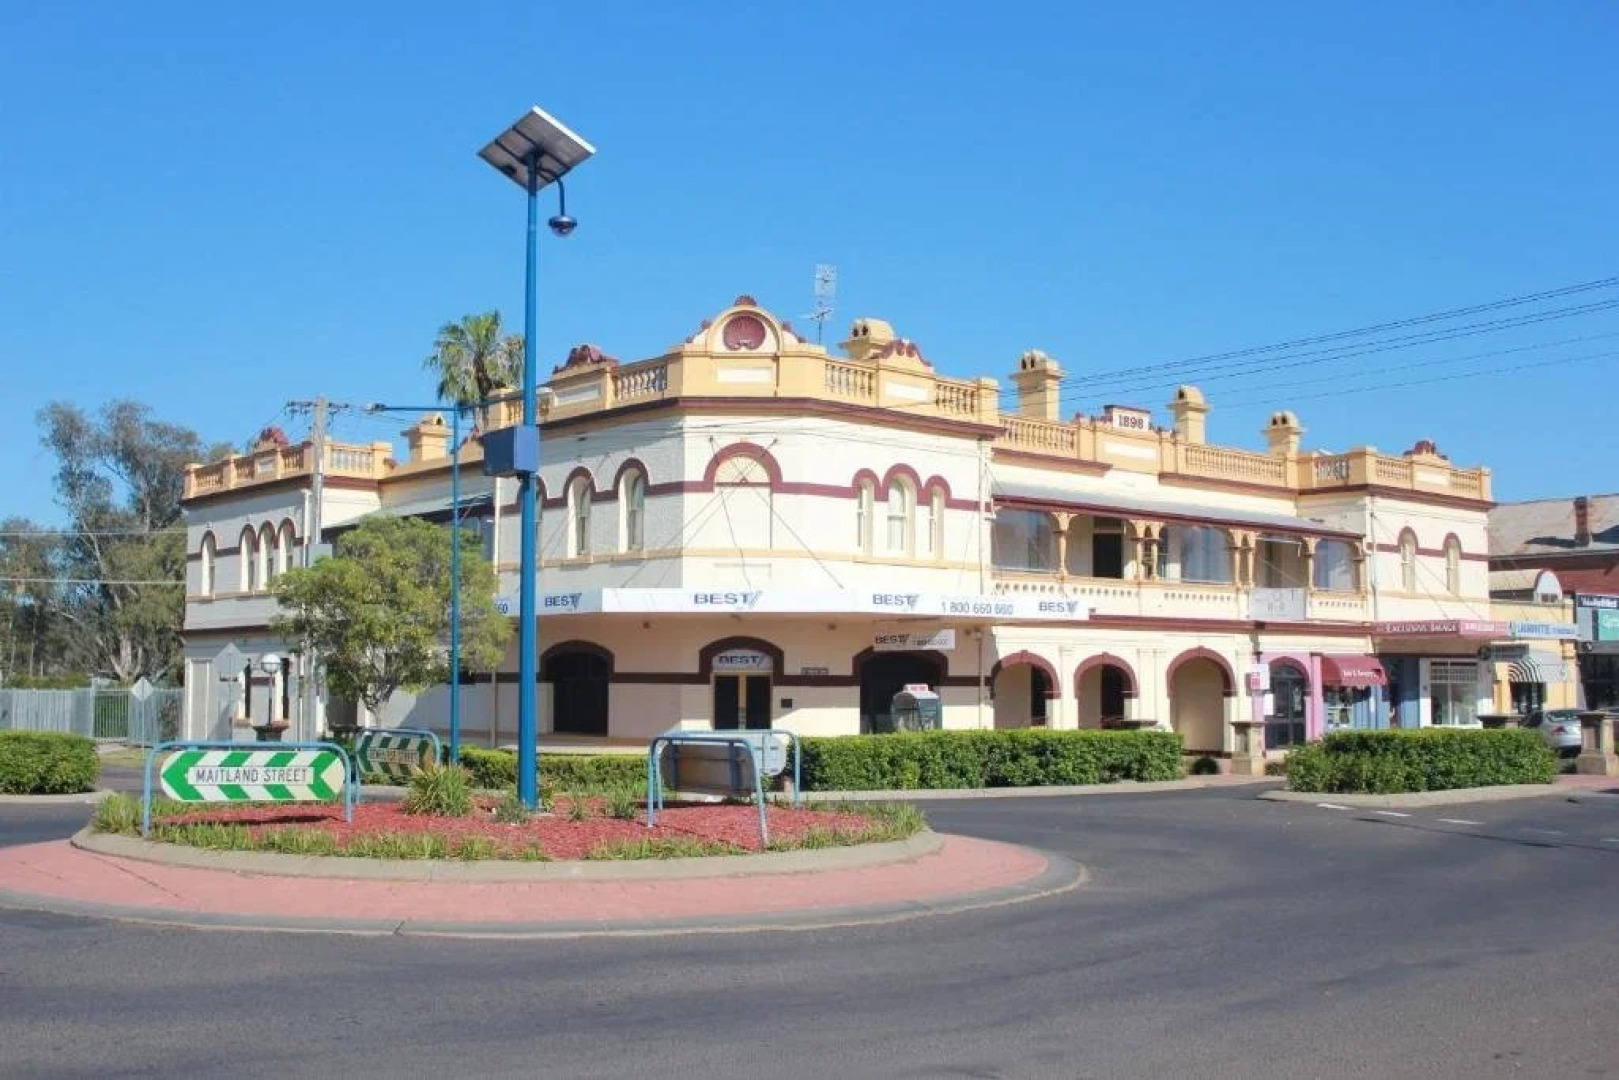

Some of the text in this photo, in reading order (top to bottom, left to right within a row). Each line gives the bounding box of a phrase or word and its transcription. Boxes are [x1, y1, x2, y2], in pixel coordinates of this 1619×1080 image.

[1118, 414, 1144, 430] 1898
[544, 594, 579, 608] BEST
[694, 592, 755, 605] BEST
[872, 593, 914, 606] BEST
[949, 601, 970, 613] 800
[973, 603, 992, 614] 660
[875, 634, 908, 645] BEST
[718, 655, 760, 665] BEST
[195, 768, 308, 782] MAITLAND STREET
